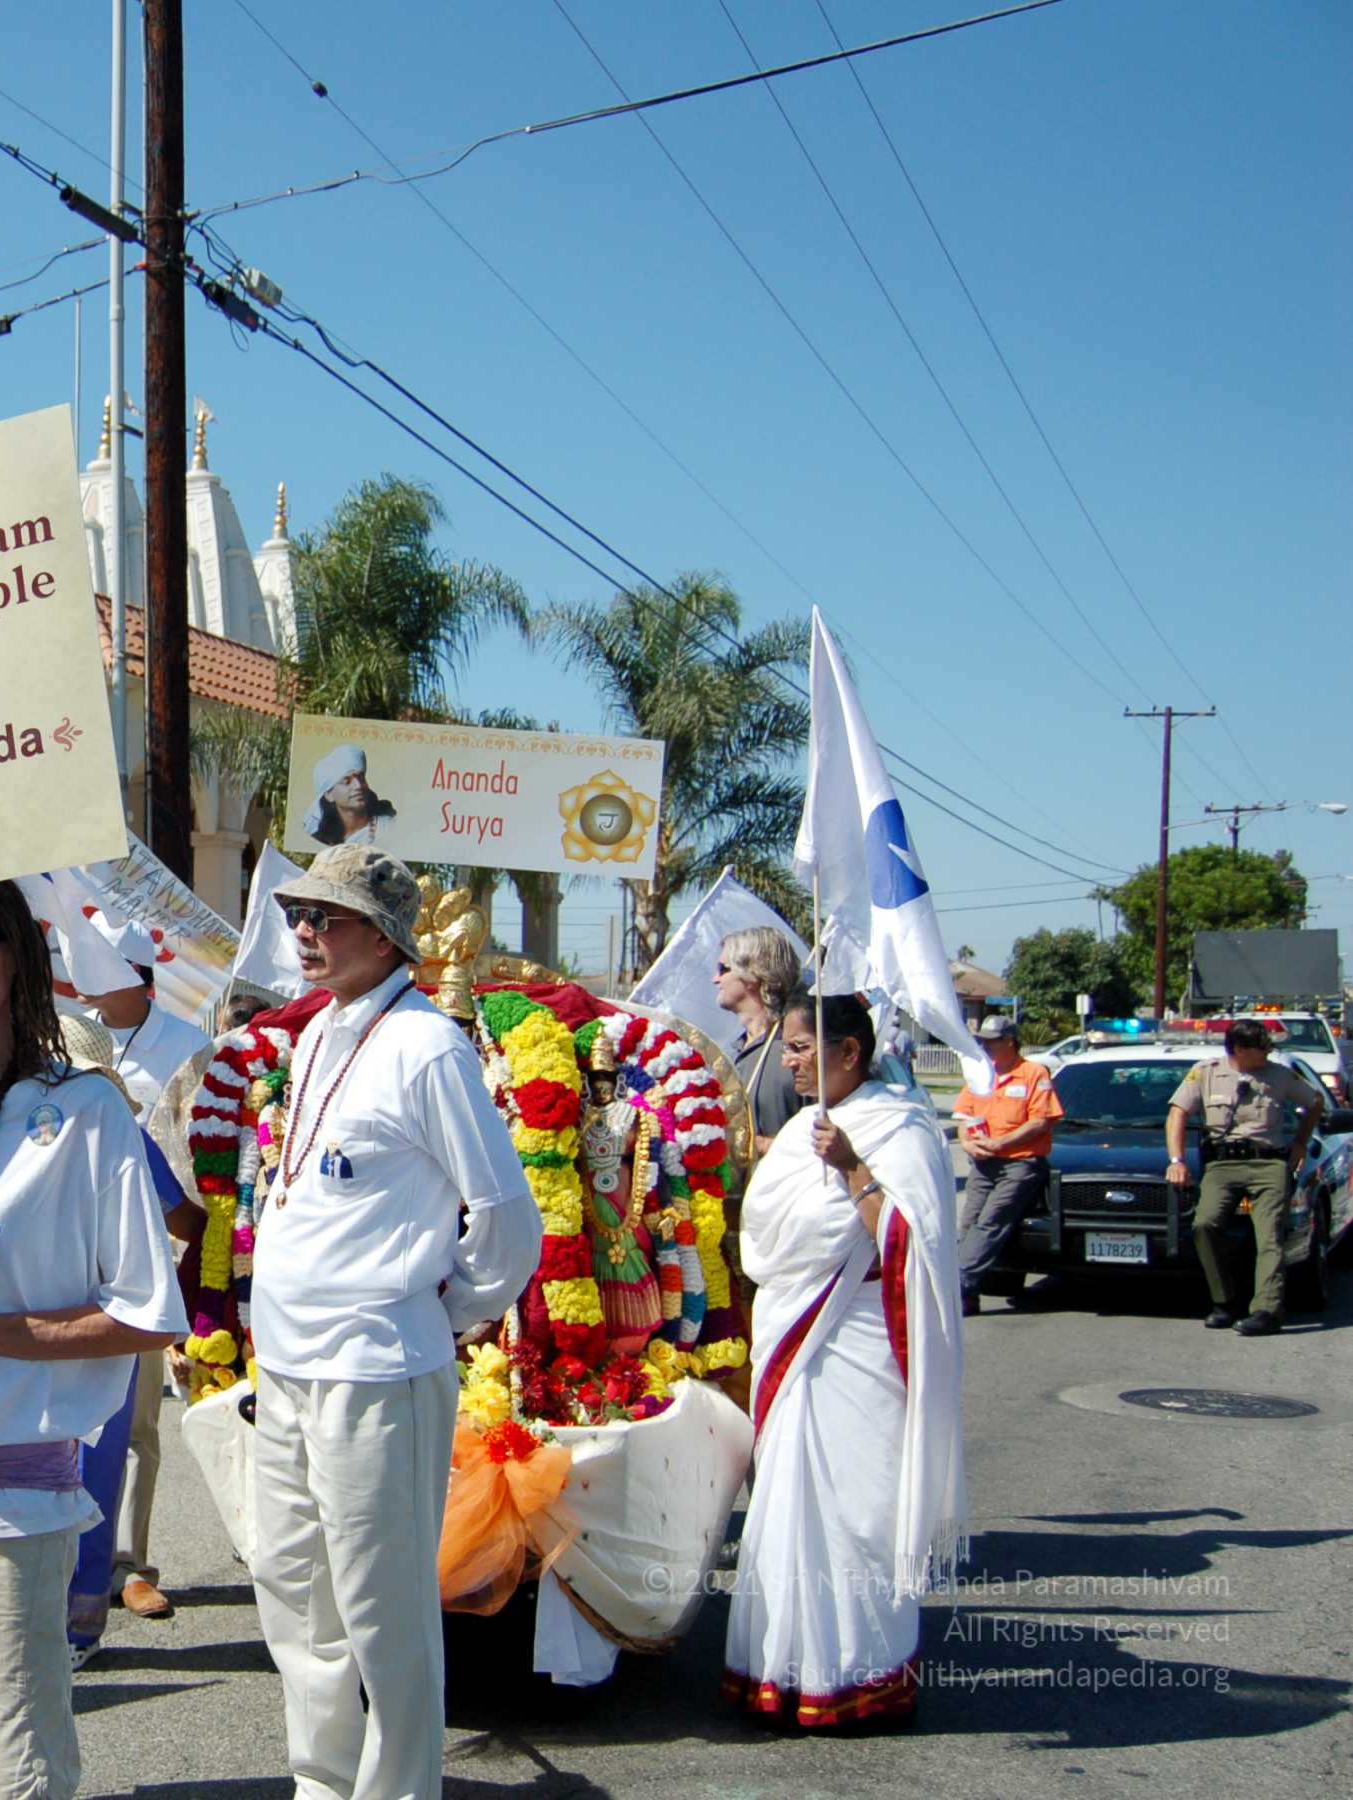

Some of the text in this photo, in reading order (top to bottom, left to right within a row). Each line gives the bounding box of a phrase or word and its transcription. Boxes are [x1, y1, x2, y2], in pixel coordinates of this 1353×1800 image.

[430, 757, 519, 796] Ananda
[439, 800, 504, 845] Surya
[1090, 1241, 1143, 1258] 1178239
